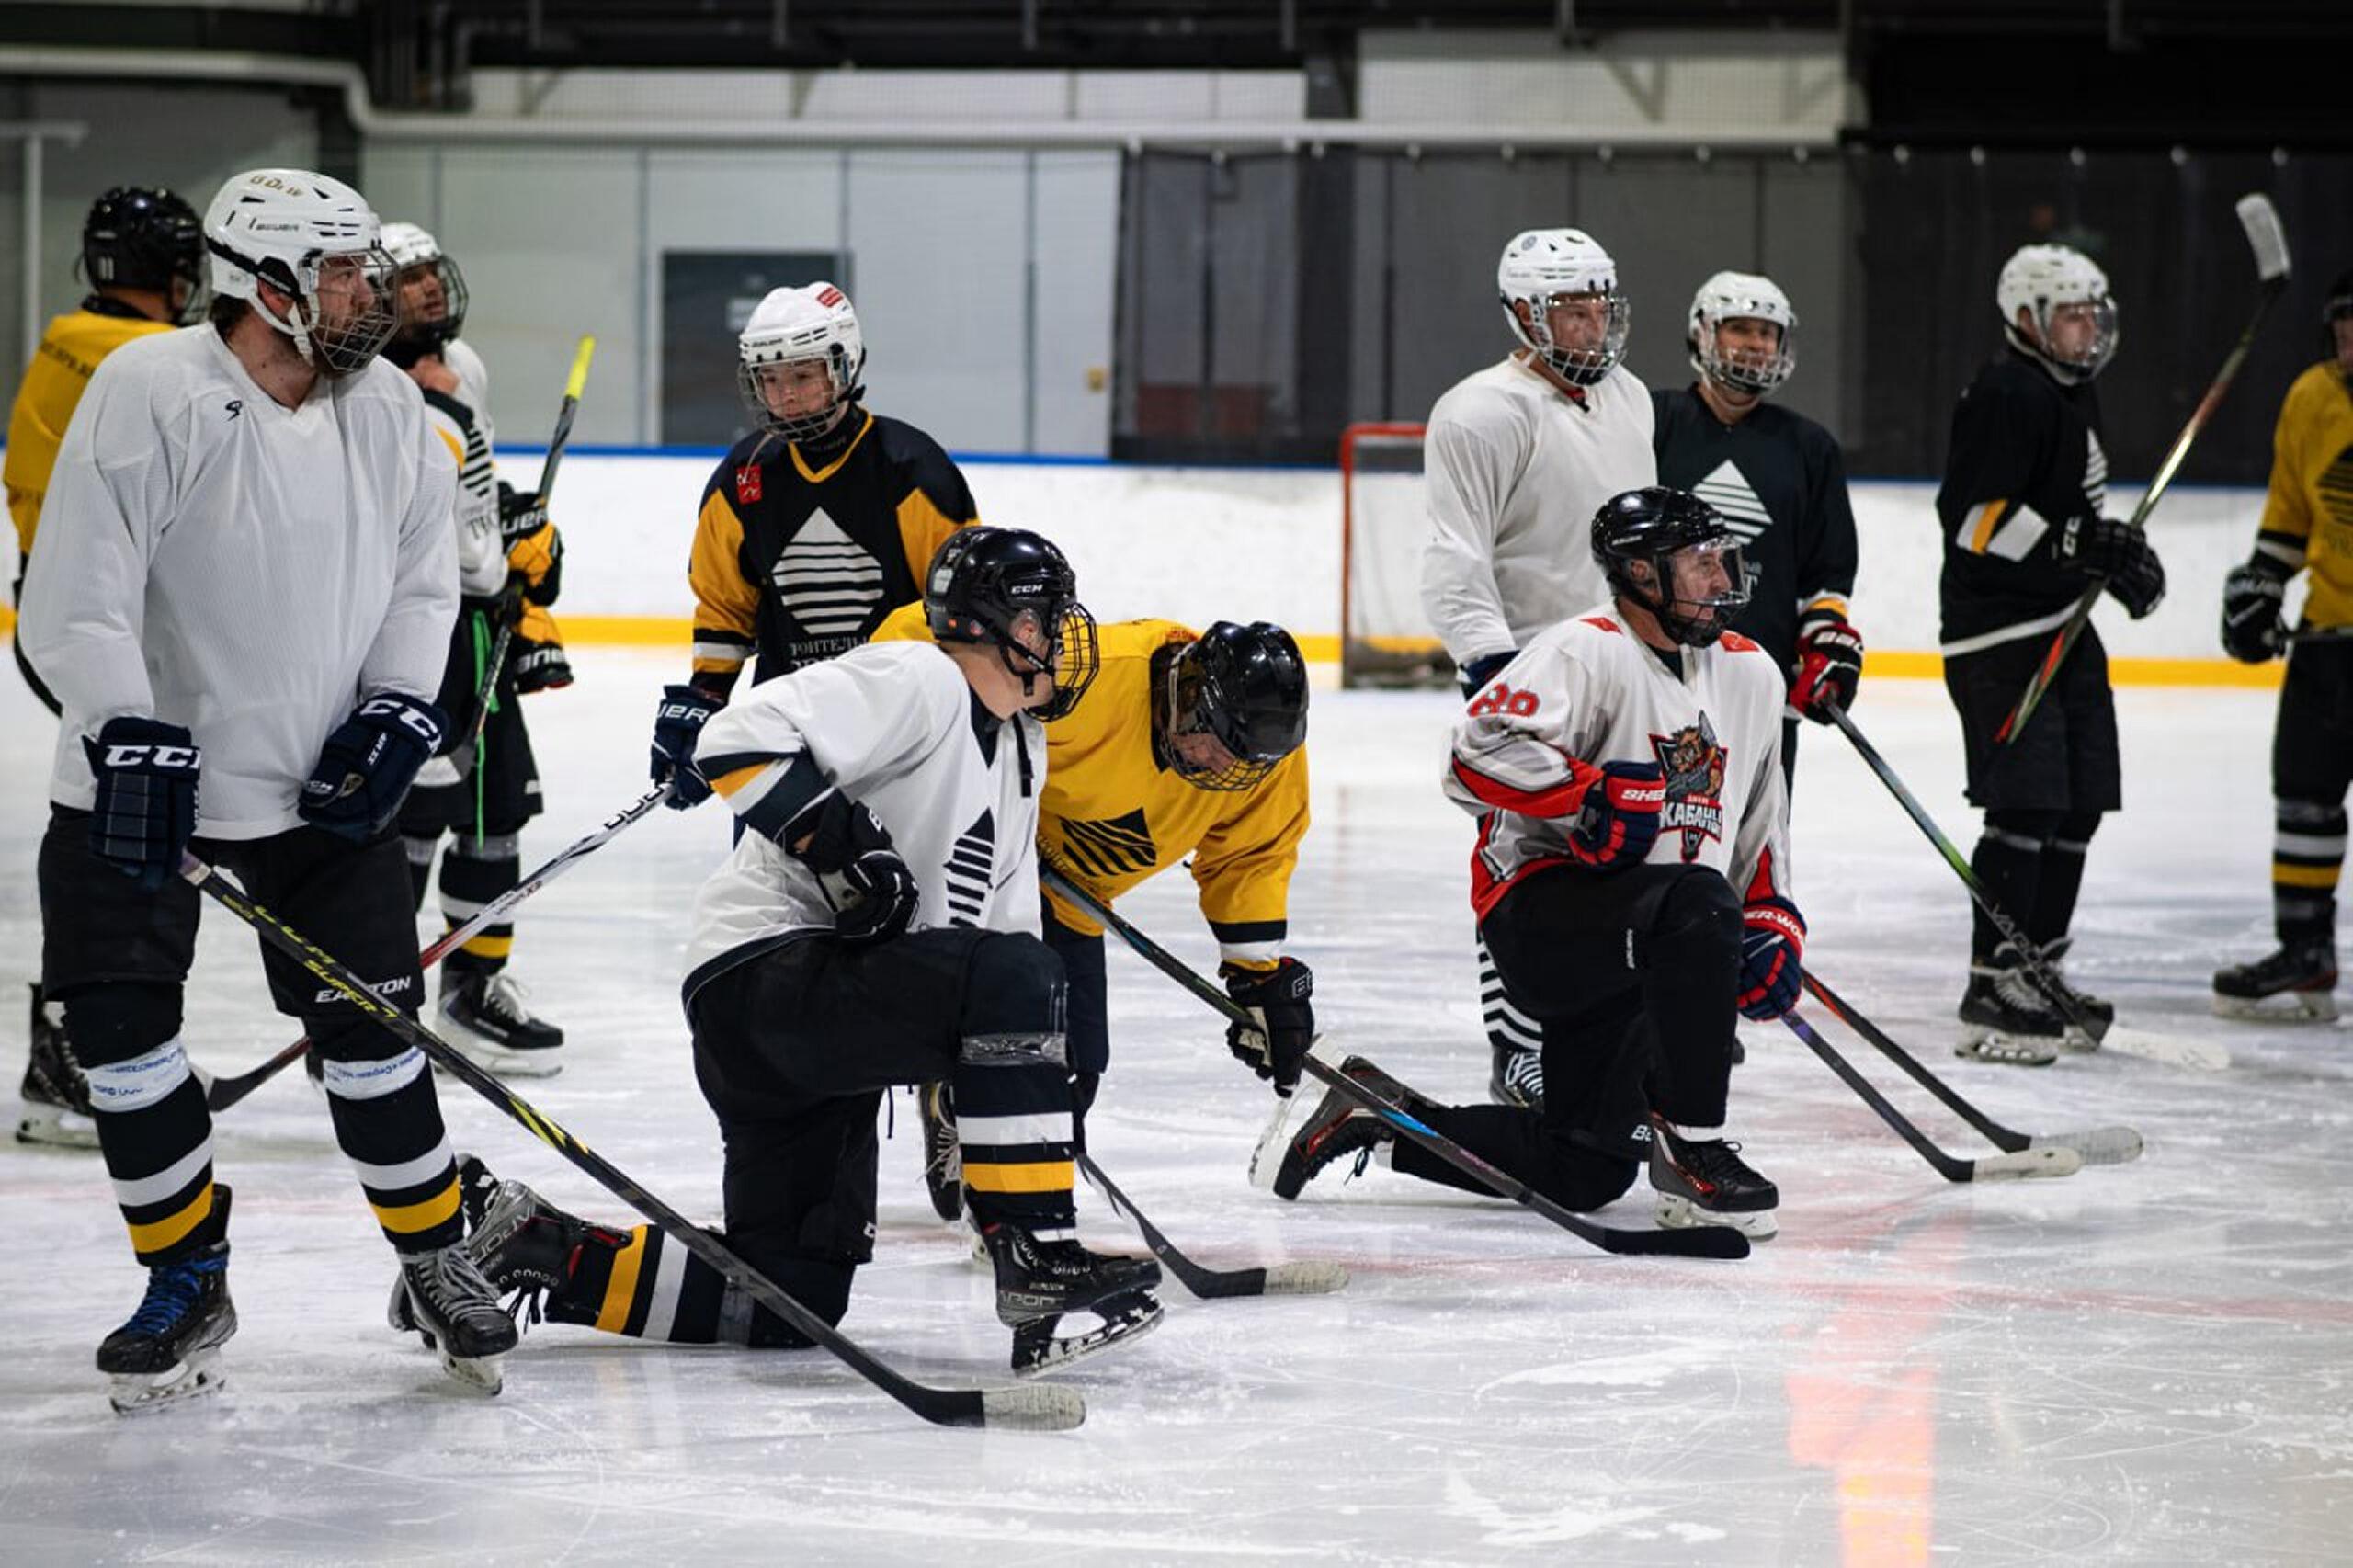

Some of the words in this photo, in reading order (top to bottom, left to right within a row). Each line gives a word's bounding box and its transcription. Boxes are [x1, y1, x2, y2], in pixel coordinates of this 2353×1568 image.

[1012, 584, 1044, 594] CCM
[304, 959, 378, 1013] SUPER
[315, 975, 412, 1004] EATON
